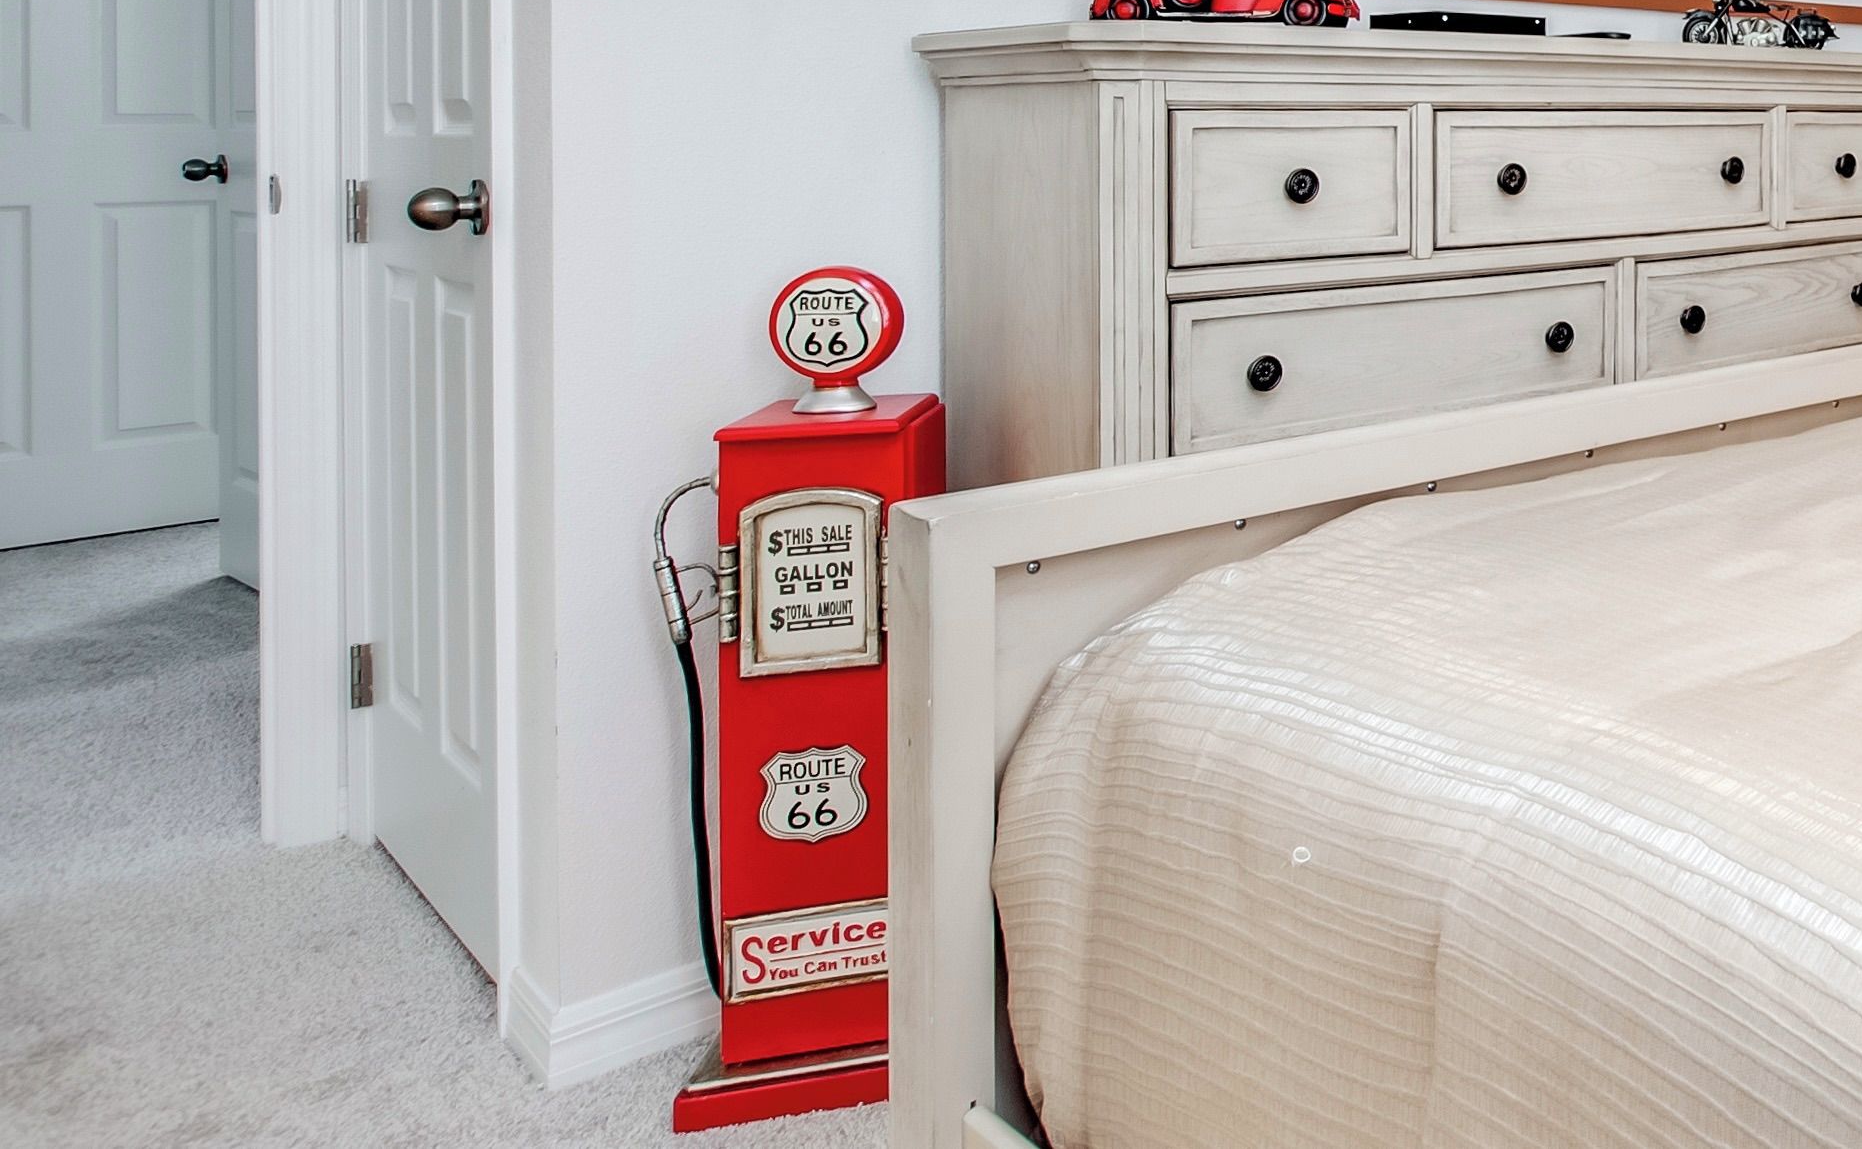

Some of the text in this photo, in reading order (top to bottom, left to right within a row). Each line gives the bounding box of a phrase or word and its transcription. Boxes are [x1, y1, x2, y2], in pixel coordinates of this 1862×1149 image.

[799, 296, 855, 311] ROUTE
[811, 317, 841, 327] US
[804, 331, 848, 356] 66
[821, 524, 853, 543] SALE
[774, 560, 854, 583] GALLON
[817, 599, 854, 617] AMOUNT
[779, 757, 846, 782] ROUTE
[794, 782, 831, 795] US
[787, 797, 838, 830] 66
[740, 920, 887, 985] Service
[768, 950, 888, 981] You Can Trust
